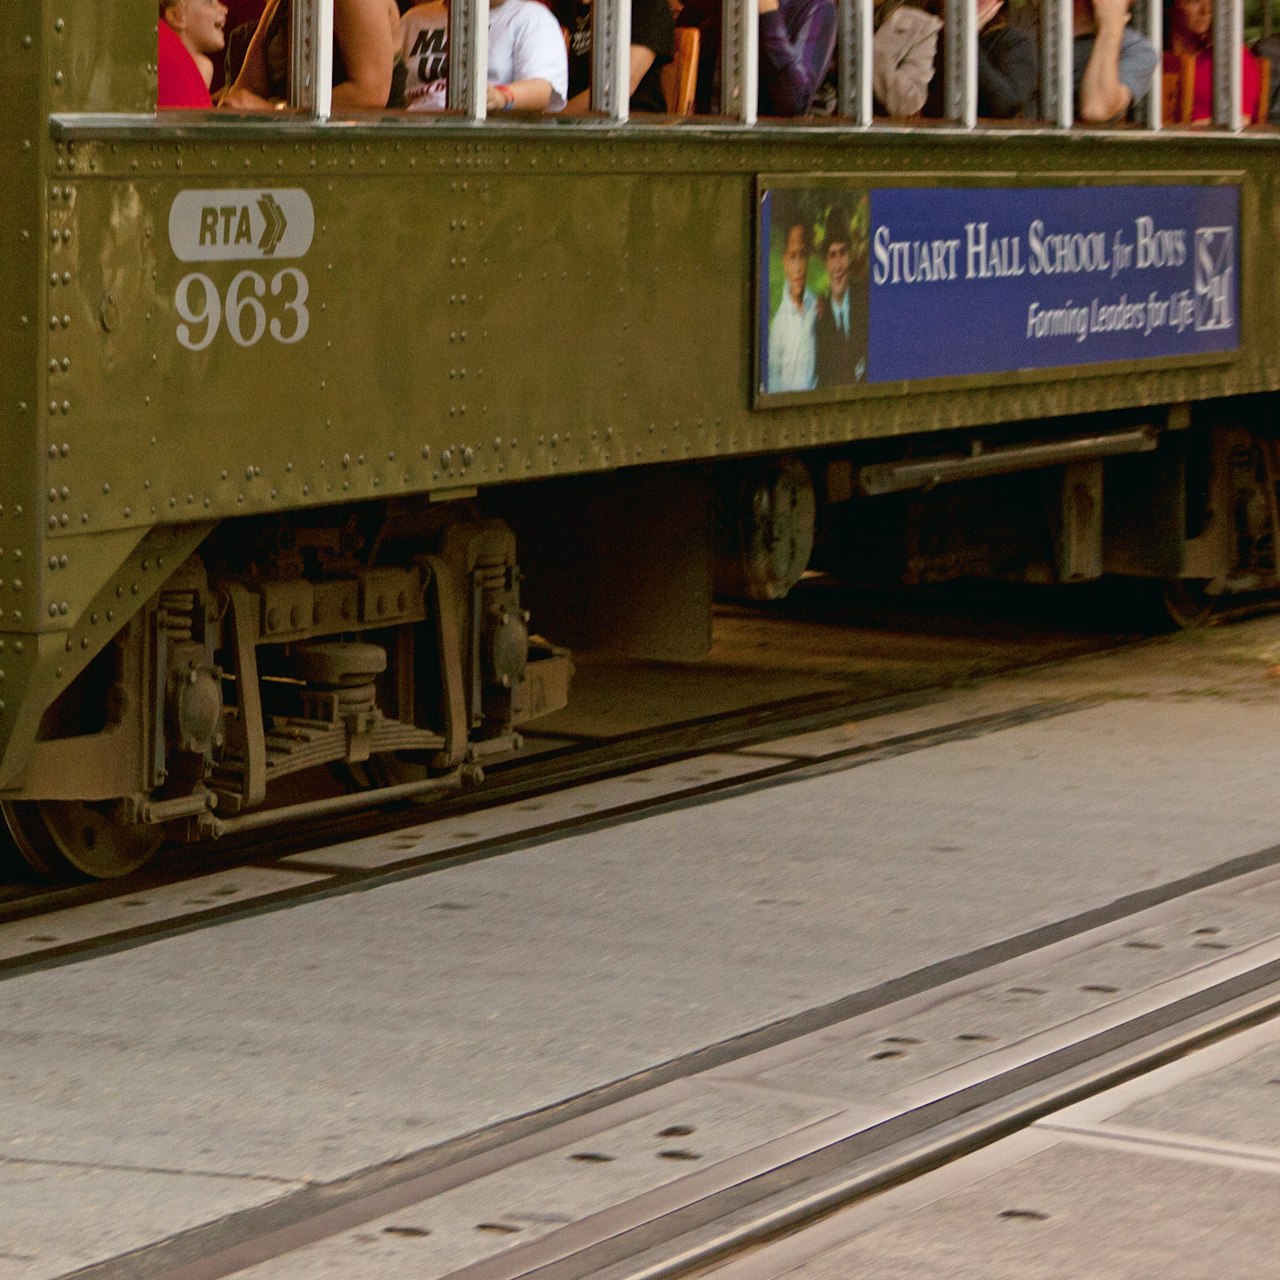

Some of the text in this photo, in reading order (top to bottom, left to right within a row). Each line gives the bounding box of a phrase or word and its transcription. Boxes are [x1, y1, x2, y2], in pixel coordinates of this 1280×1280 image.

[199, 205, 253, 247] RTA
[1110, 228, 1135, 280] for
[174, 268, 310, 351] 963
[1025, 289, 1195, 344] Forming Leaders for Life
